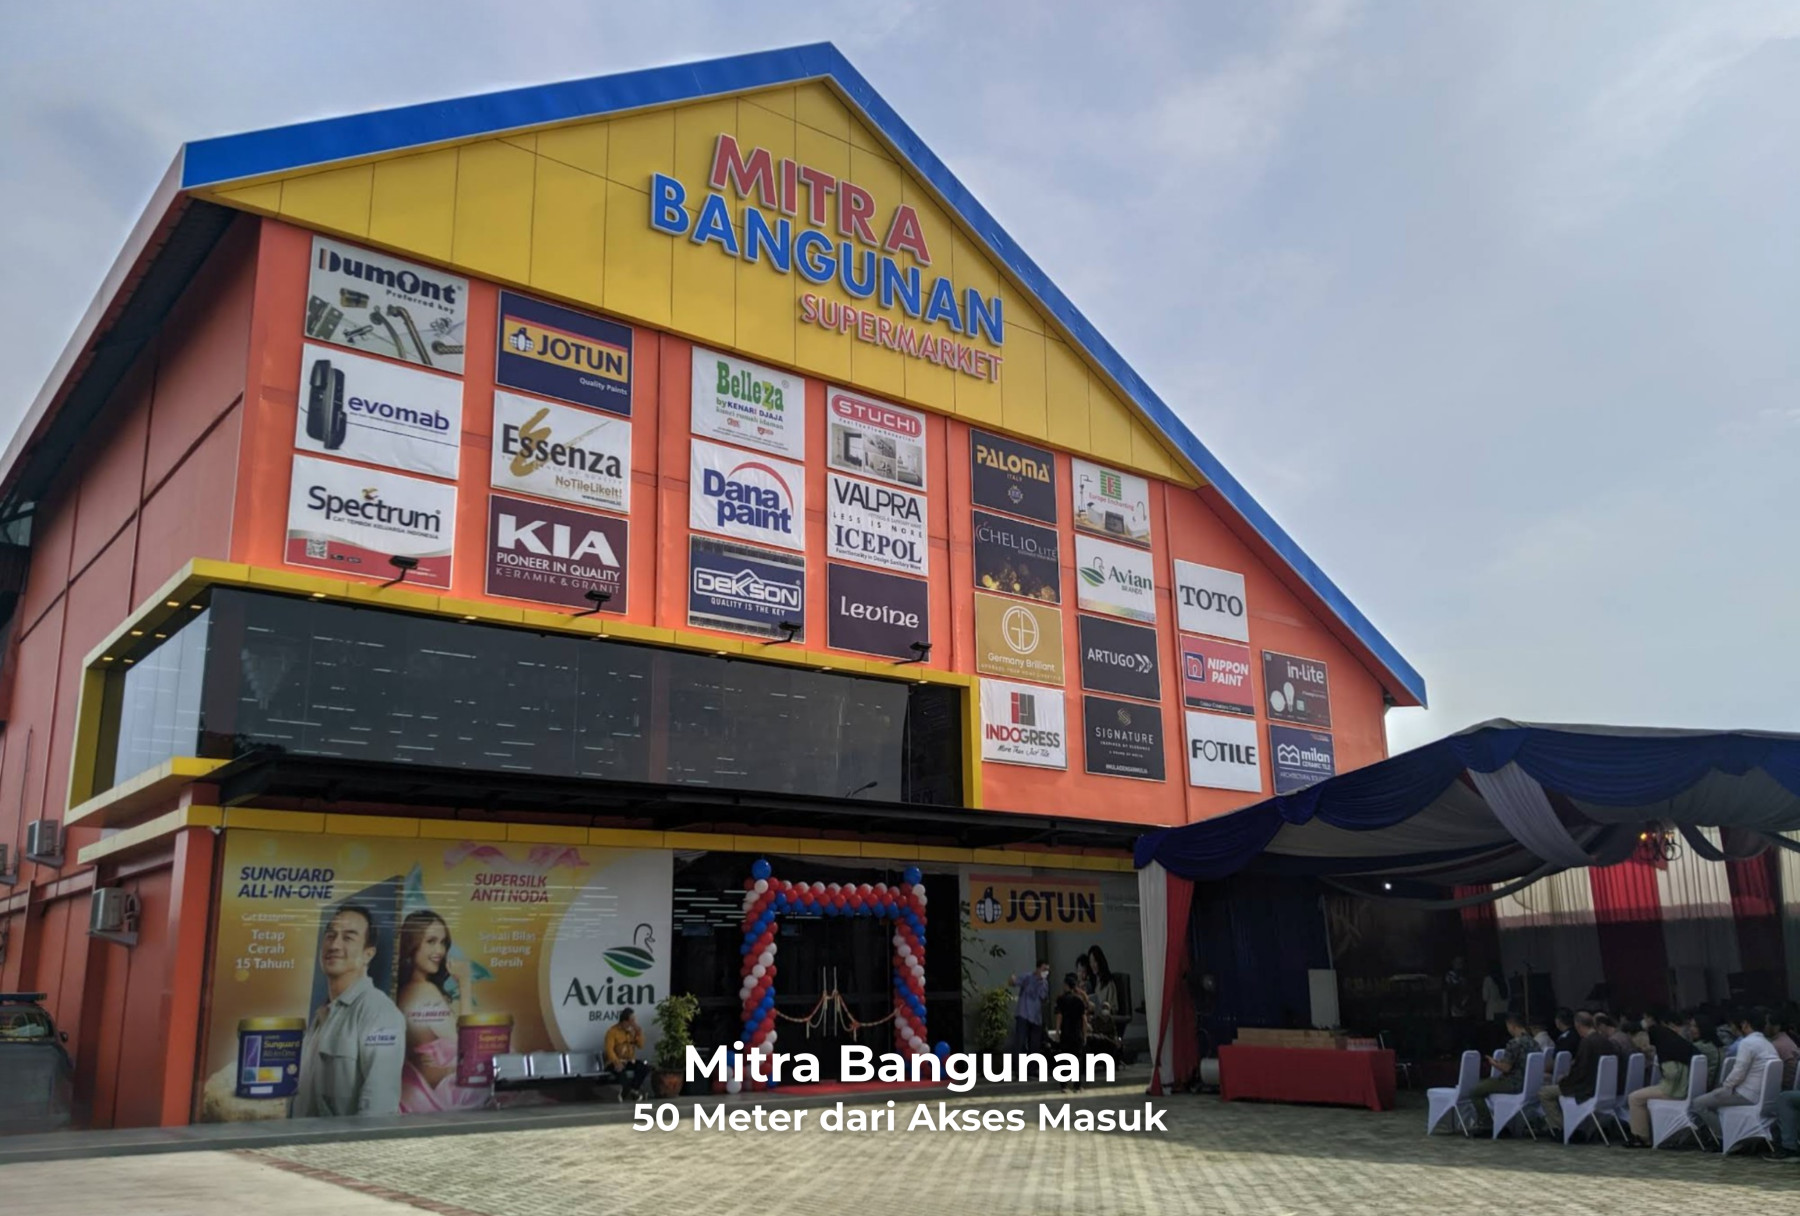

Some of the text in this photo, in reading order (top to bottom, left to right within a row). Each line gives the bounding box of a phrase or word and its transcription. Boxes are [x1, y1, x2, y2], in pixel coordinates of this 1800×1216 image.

[709, 132, 931, 266] MITRA
[650, 171, 1004, 346] BANGUNAN
[802, 293, 1004, 383] SUPERMARKET
[537, 333, 624, 376] JOTUN
[579, 377, 629, 396] Quality Paints
[348, 396, 450, 431] evomab
[716, 397, 784, 423] by KENARI DJAJA
[838, 400, 916, 434] STUCHI
[502, 423, 623, 479] Essenza
[976, 444, 1050, 483] PALOMA
[555, 475, 623, 498] NoTileLikeIt!
[703, 468, 780, 511] Dana
[1006, 473, 1023, 483] ITALY
[307, 485, 441, 533] Spectrum
[833, 477, 922, 523] VALPRA
[717, 499, 792, 534] paint
[833, 511, 861, 525] LESS
[498, 512, 621, 568] KIA
[834, 524, 922, 564] ICEPOL
[977, 526, 1038, 554] CHELIO
[1038, 545, 1057, 559] LITE
[496, 551, 621, 583] PIONEER IN QUALITY
[1108, 565, 1153, 591] Avian
[560, 577, 569, 586] &
[571, 580, 621, 594] GRANIT
[1121, 584, 1143, 595] BRANDS
[710, 597, 786, 617] QUALITY IS THE KEY
[840, 595, 919, 629] Levine
[1179, 584, 1244, 618] TOTO
[987, 652, 1056, 673] Germany Brilliant
[1087, 648, 1135, 668] ARTUGO
[1207, 657, 1250, 676] NIPPON
[1211, 670, 1244, 687] PAINT
[986, 724, 1061, 748] INDOGRESS
[1095, 726, 1155, 745] SIGNATURE
[1191, 739, 1257, 766] FOTILE
[1301, 747, 1330, 763] milan
[240, 866, 335, 883] SUNGUARD
[474, 873, 548, 889] SUPERSILK
[237, 884, 334, 900] ALL-IN-ONE
[470, 888, 550, 904] ANTI NODA
[1005, 890, 1097, 924] JOTUN
[247, 942, 285, 955] Cerah
[251, 929, 286, 943] Tetap
[236, 958, 295, 970] 15 Tahun!
[562, 976, 656, 1007] Avian
[588, 1010, 621, 1022] BRAN
